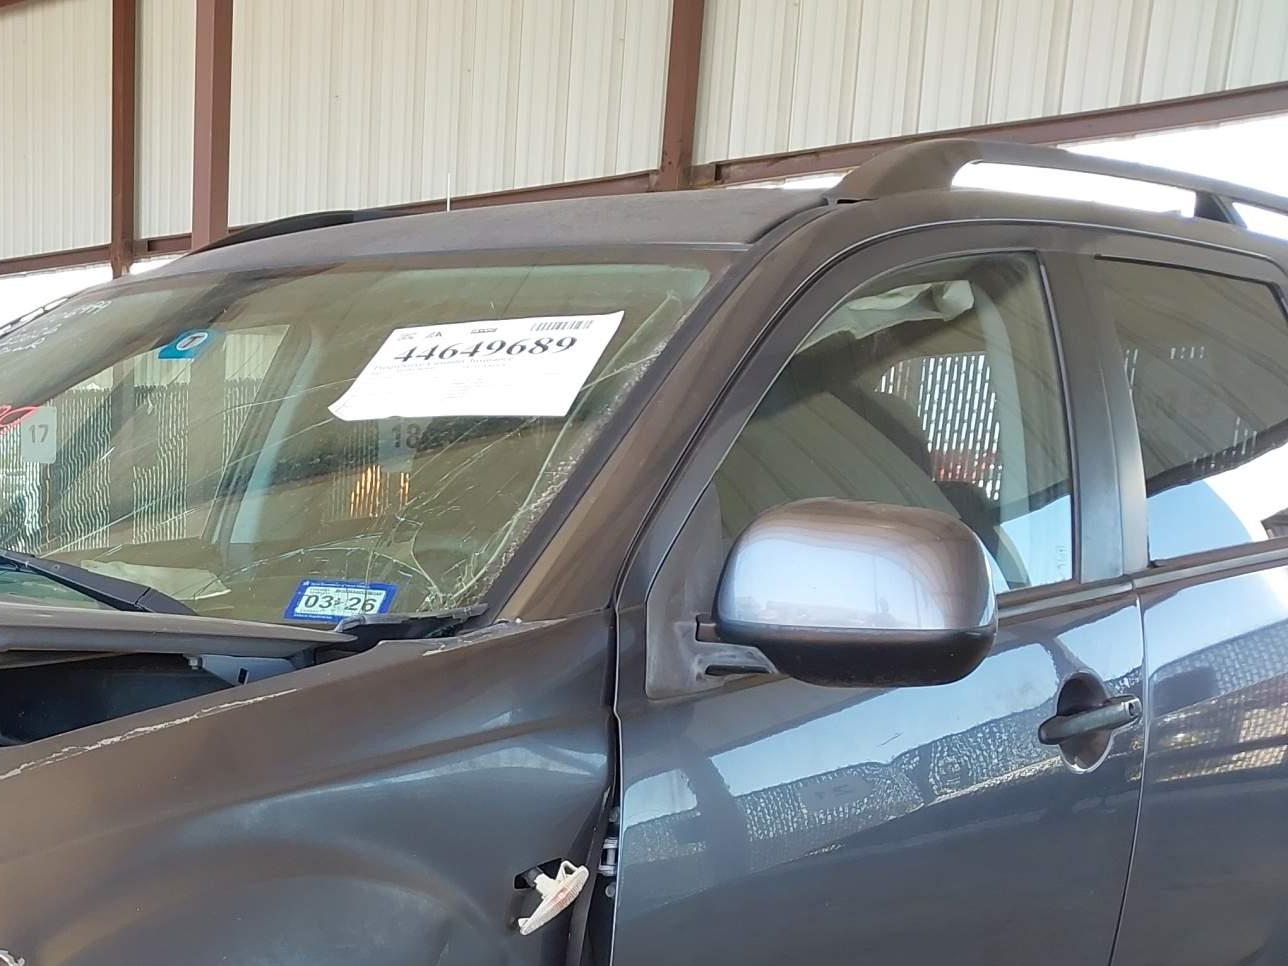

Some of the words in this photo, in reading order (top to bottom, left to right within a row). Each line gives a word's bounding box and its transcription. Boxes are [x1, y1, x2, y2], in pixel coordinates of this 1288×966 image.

[393, 336, 578, 362] 44649689
[29, 424, 49, 443] 17
[392, 423, 421, 448] 18
[304, 594, 333, 609] 03
[343, 597, 377, 612] 26
